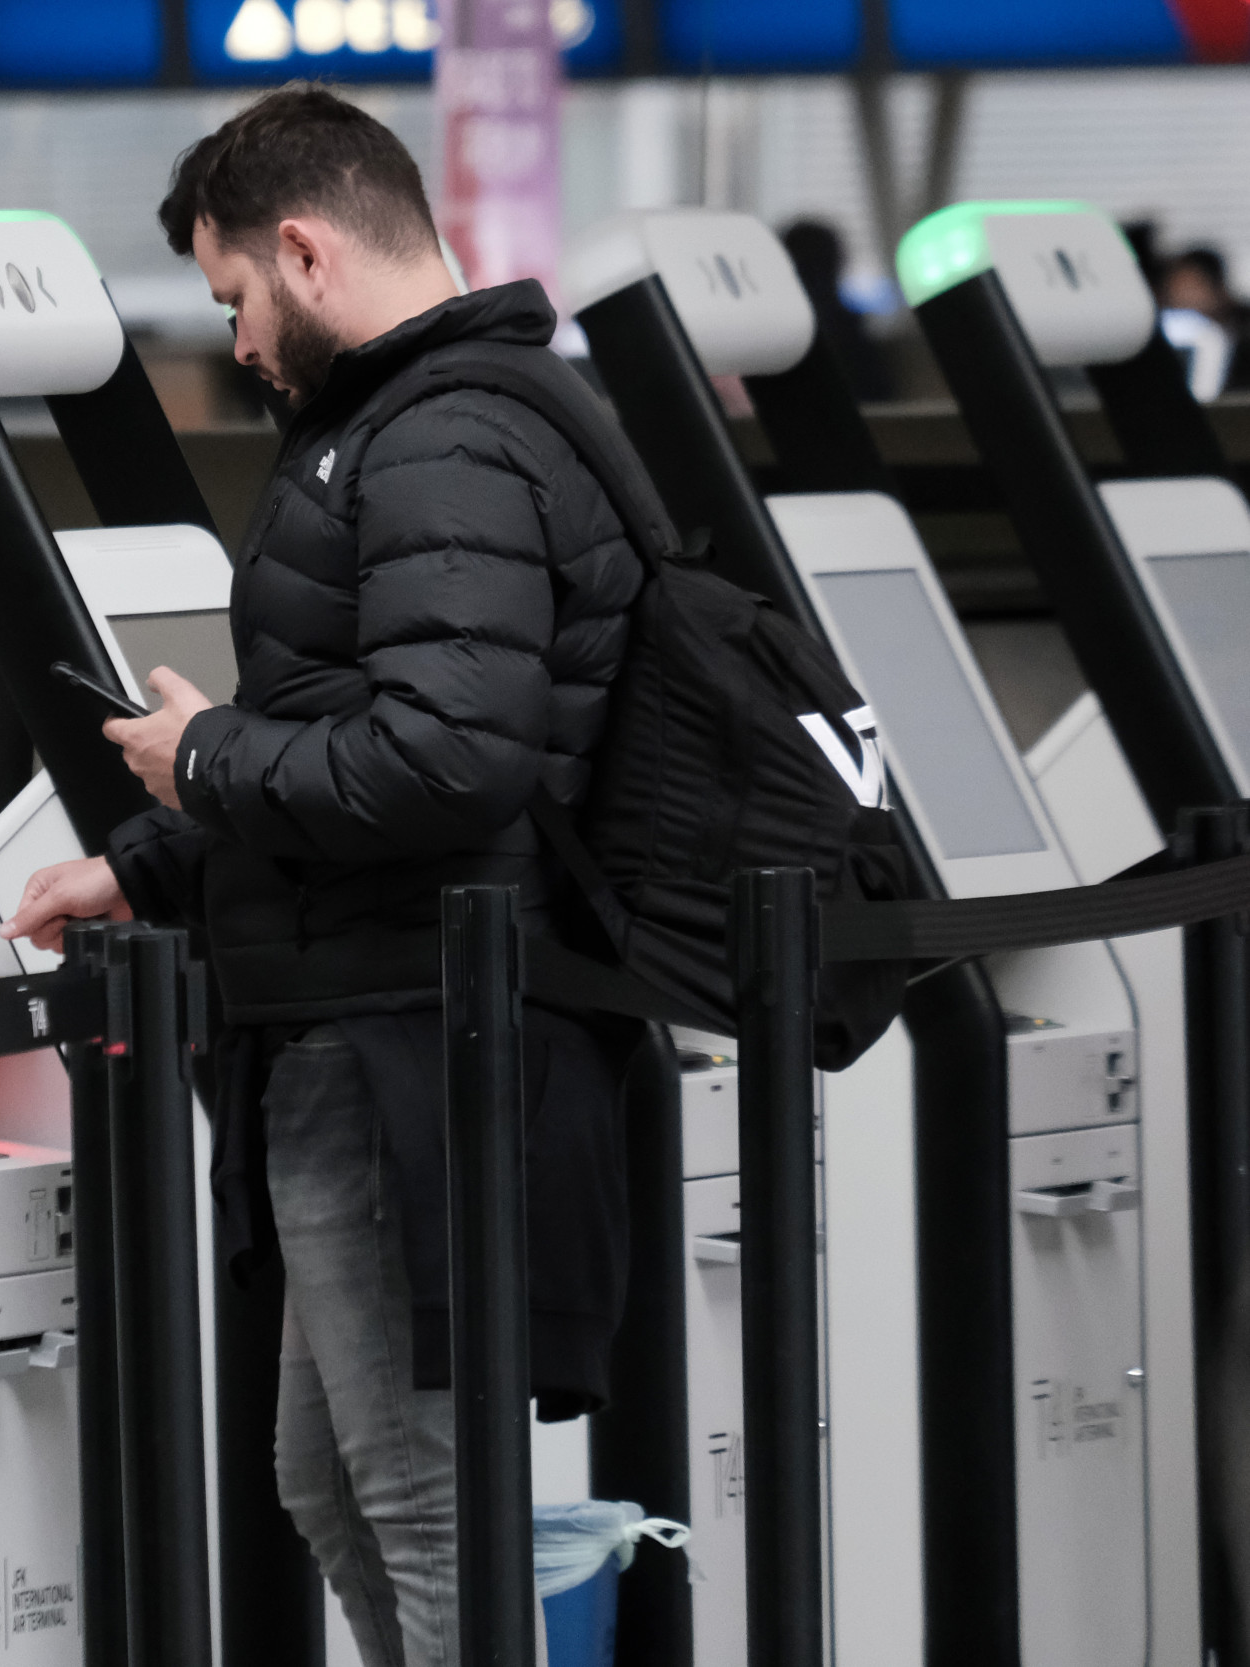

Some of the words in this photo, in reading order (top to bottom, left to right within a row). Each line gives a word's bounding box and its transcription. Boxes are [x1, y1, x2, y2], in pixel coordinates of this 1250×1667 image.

[12, 1583, 73, 1612] INTERNATIONAL
[12, 1613, 26, 1634] AIR
[27, 1606, 67, 1632] TERMINAL
